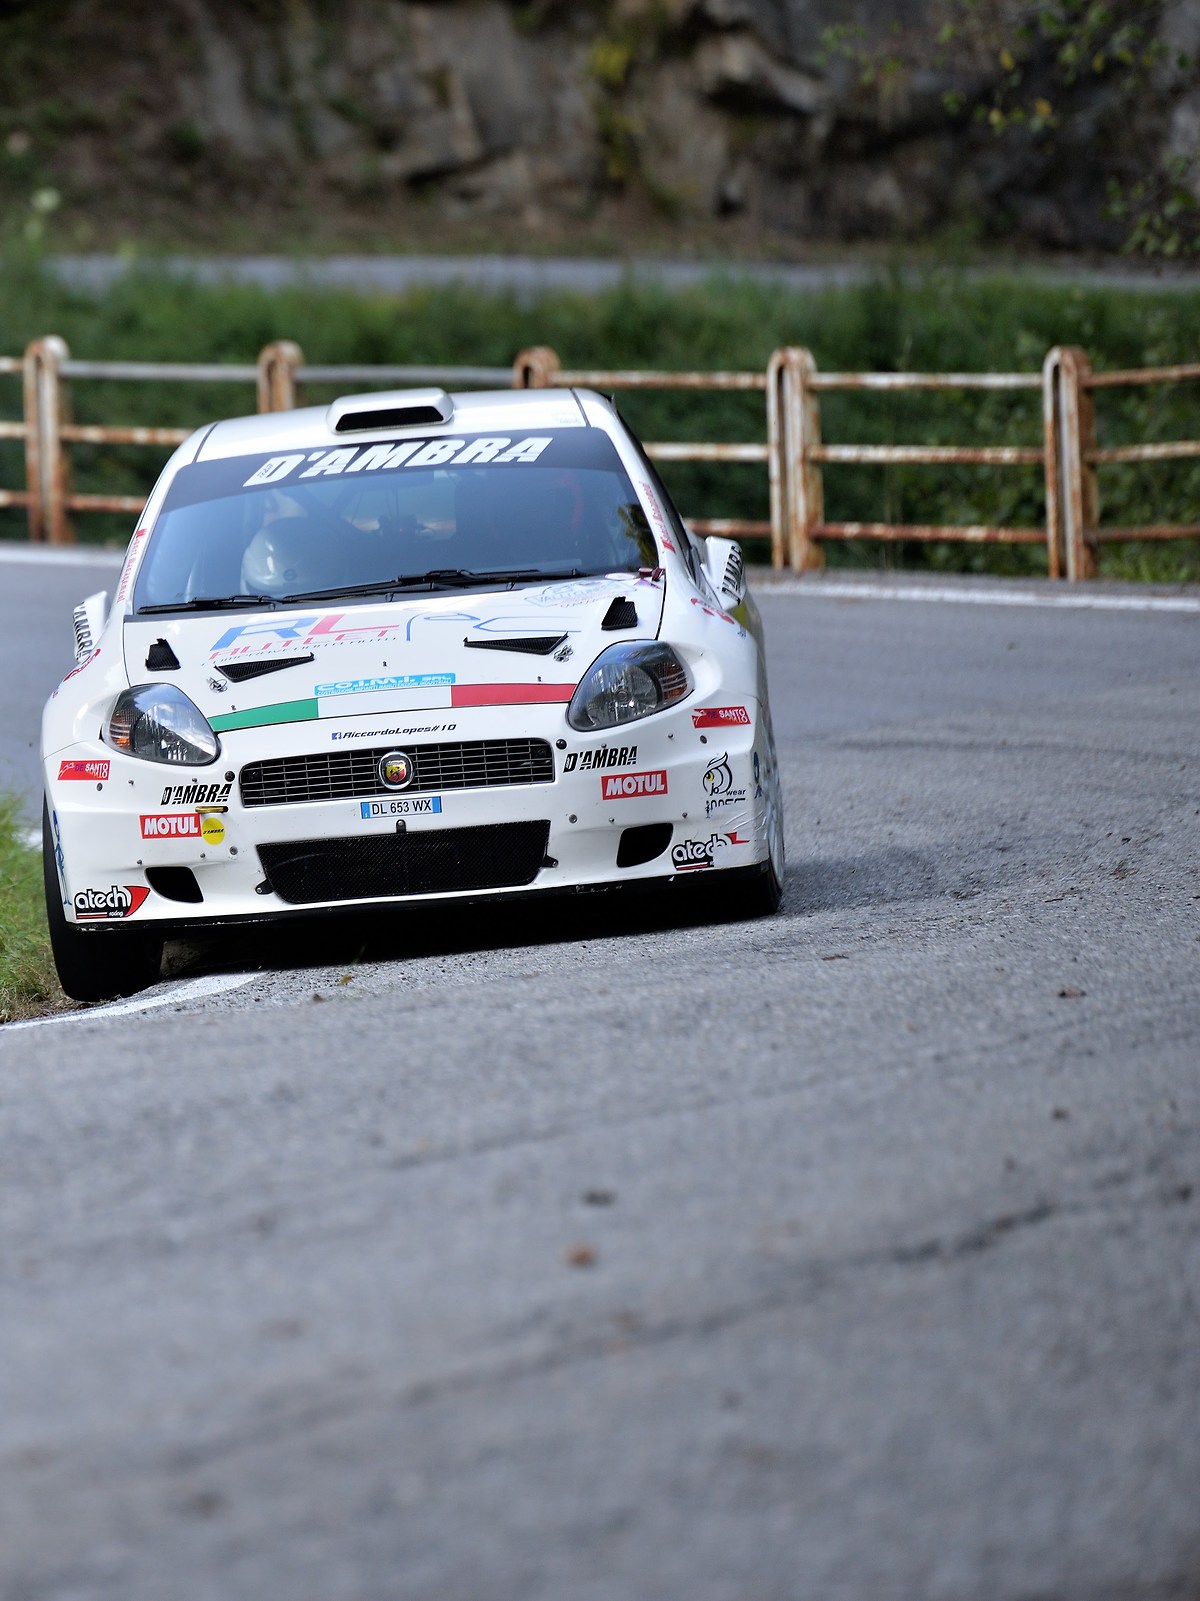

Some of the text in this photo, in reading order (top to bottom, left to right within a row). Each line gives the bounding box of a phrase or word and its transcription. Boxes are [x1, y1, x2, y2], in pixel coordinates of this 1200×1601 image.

[242, 436, 554, 487] D'AMBRA
[209, 613, 400, 651] RL
[719, 708, 746, 719] SANTO
[85, 763, 109, 774] SANTO
[563, 745, 638, 774] D'AMBRA
[160, 783, 233, 806] D'AMBRA
[605, 774, 666, 797] MOTUL
[726, 789, 746, 797] wear
[371, 799, 432, 815] DL 653 WX
[143, 816, 199, 836] MOTUL
[74, 885, 129, 910] atech
